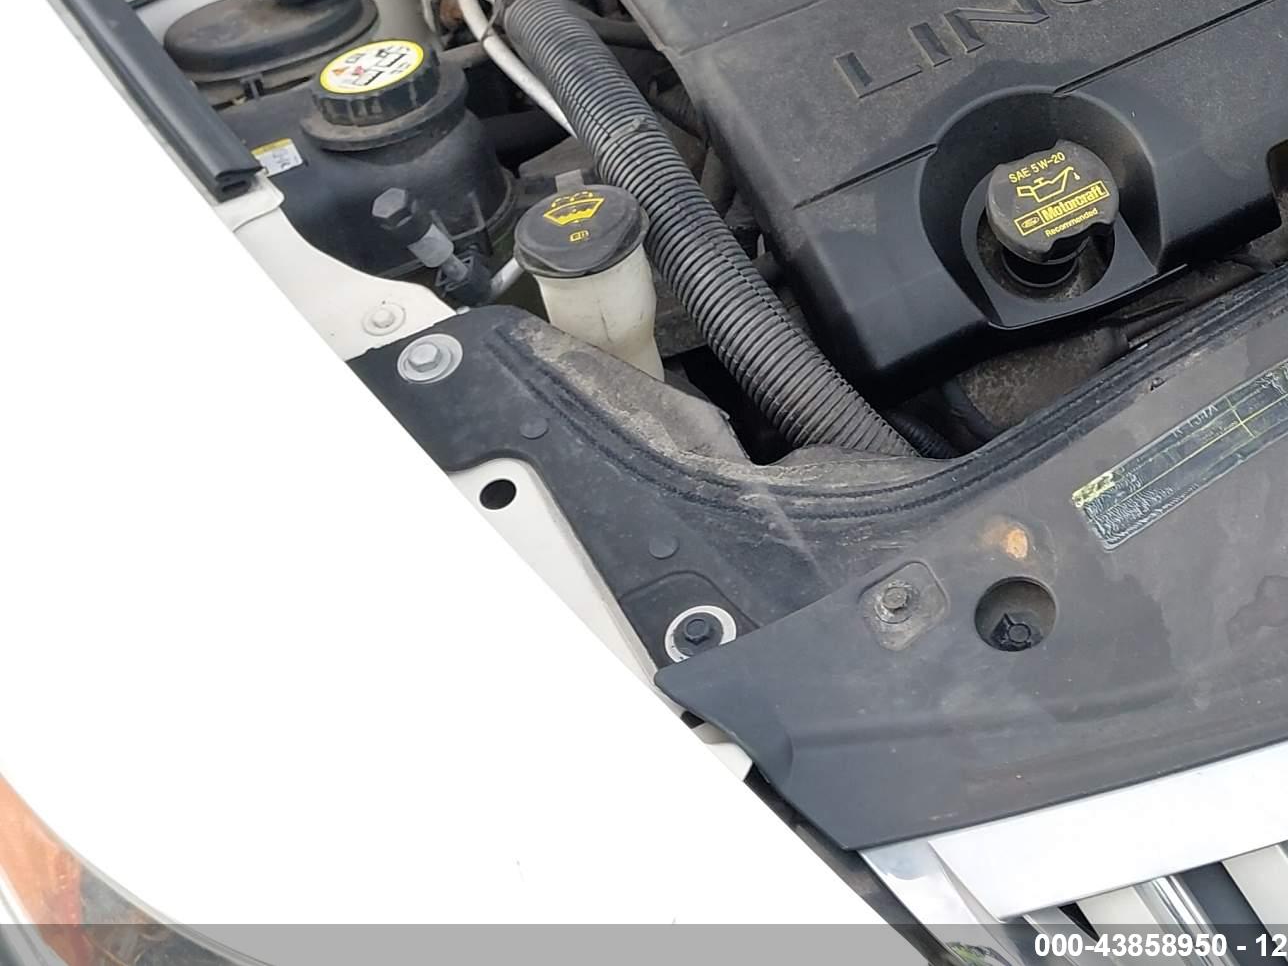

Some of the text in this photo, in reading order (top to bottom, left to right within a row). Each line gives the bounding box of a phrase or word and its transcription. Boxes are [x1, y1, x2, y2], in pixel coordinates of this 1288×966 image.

[1008, 166, 1032, 183] SAE
[1040, 185, 1107, 222] Motorcraft
[1044, 207, 1099, 238] Recommended
